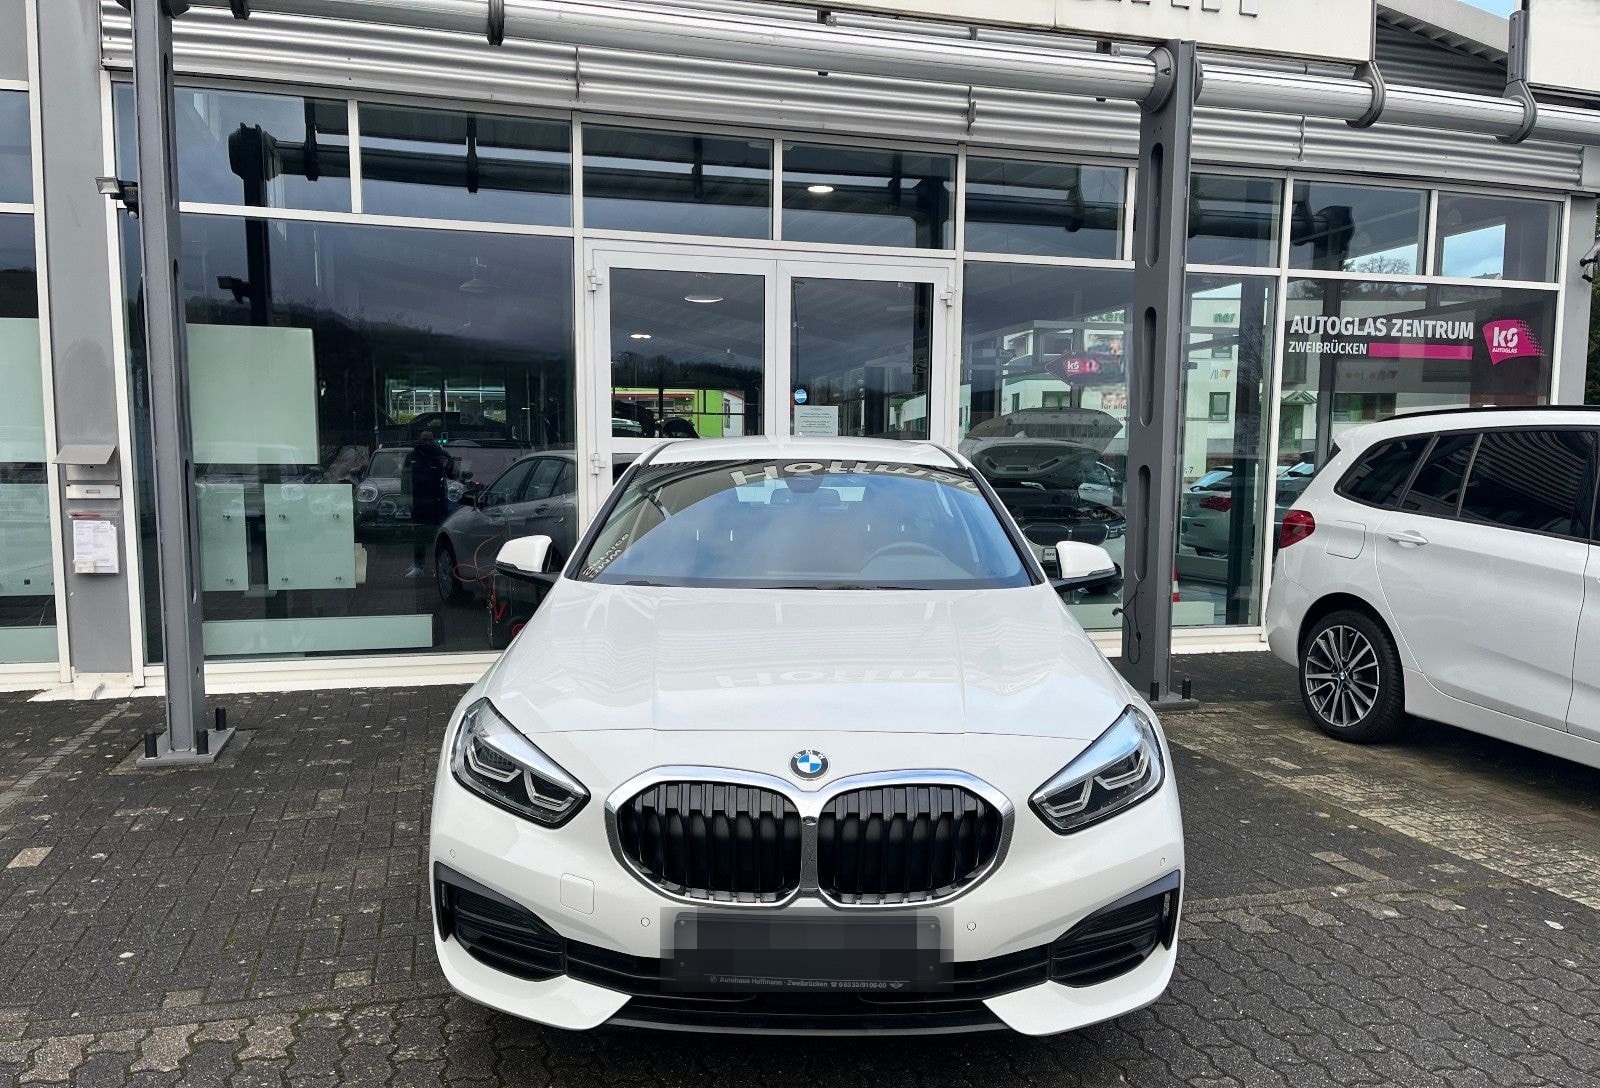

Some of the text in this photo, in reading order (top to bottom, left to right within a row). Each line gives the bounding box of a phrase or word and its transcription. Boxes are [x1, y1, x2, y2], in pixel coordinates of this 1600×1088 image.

[1290, 315, 1474, 340] AUTOGLAS ZENTRUM
[1288, 339, 1367, 355] ZWEIBRÜCKEN
[719, 976, 750, 984] Autohaus
[752, 977, 782, 985] Hoffmann
[787, 979, 828, 987] Zweibrücken
